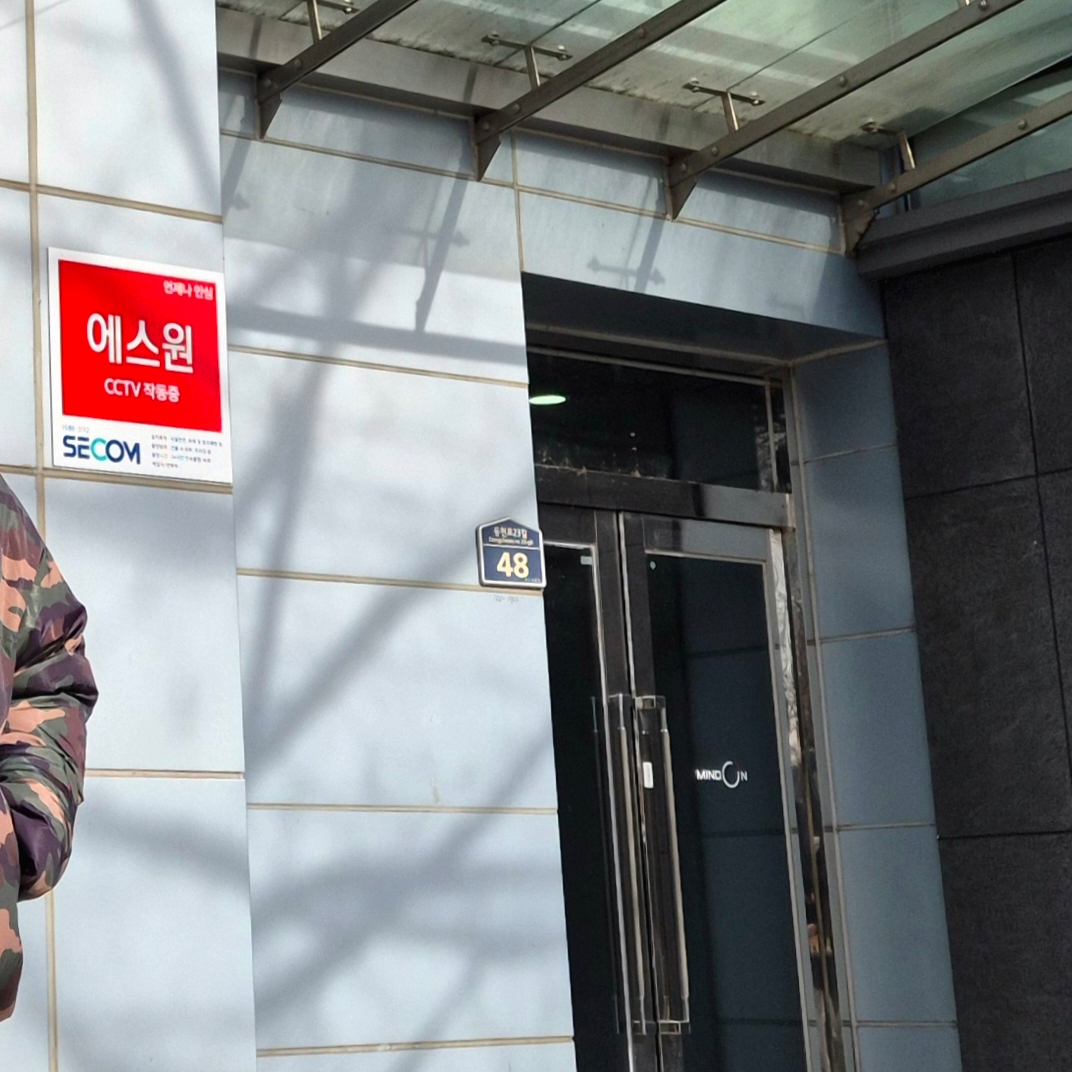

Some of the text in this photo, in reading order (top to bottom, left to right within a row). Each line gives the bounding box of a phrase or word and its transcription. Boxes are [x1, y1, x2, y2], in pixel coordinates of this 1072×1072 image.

[163, 280, 214, 300] 언제나 안심
[86, 313, 195, 374] 에스원
[104, 378, 180, 403] CCTV 작동중
[63, 435, 141, 465] SECOM
[496, 551, 529, 578] 48
